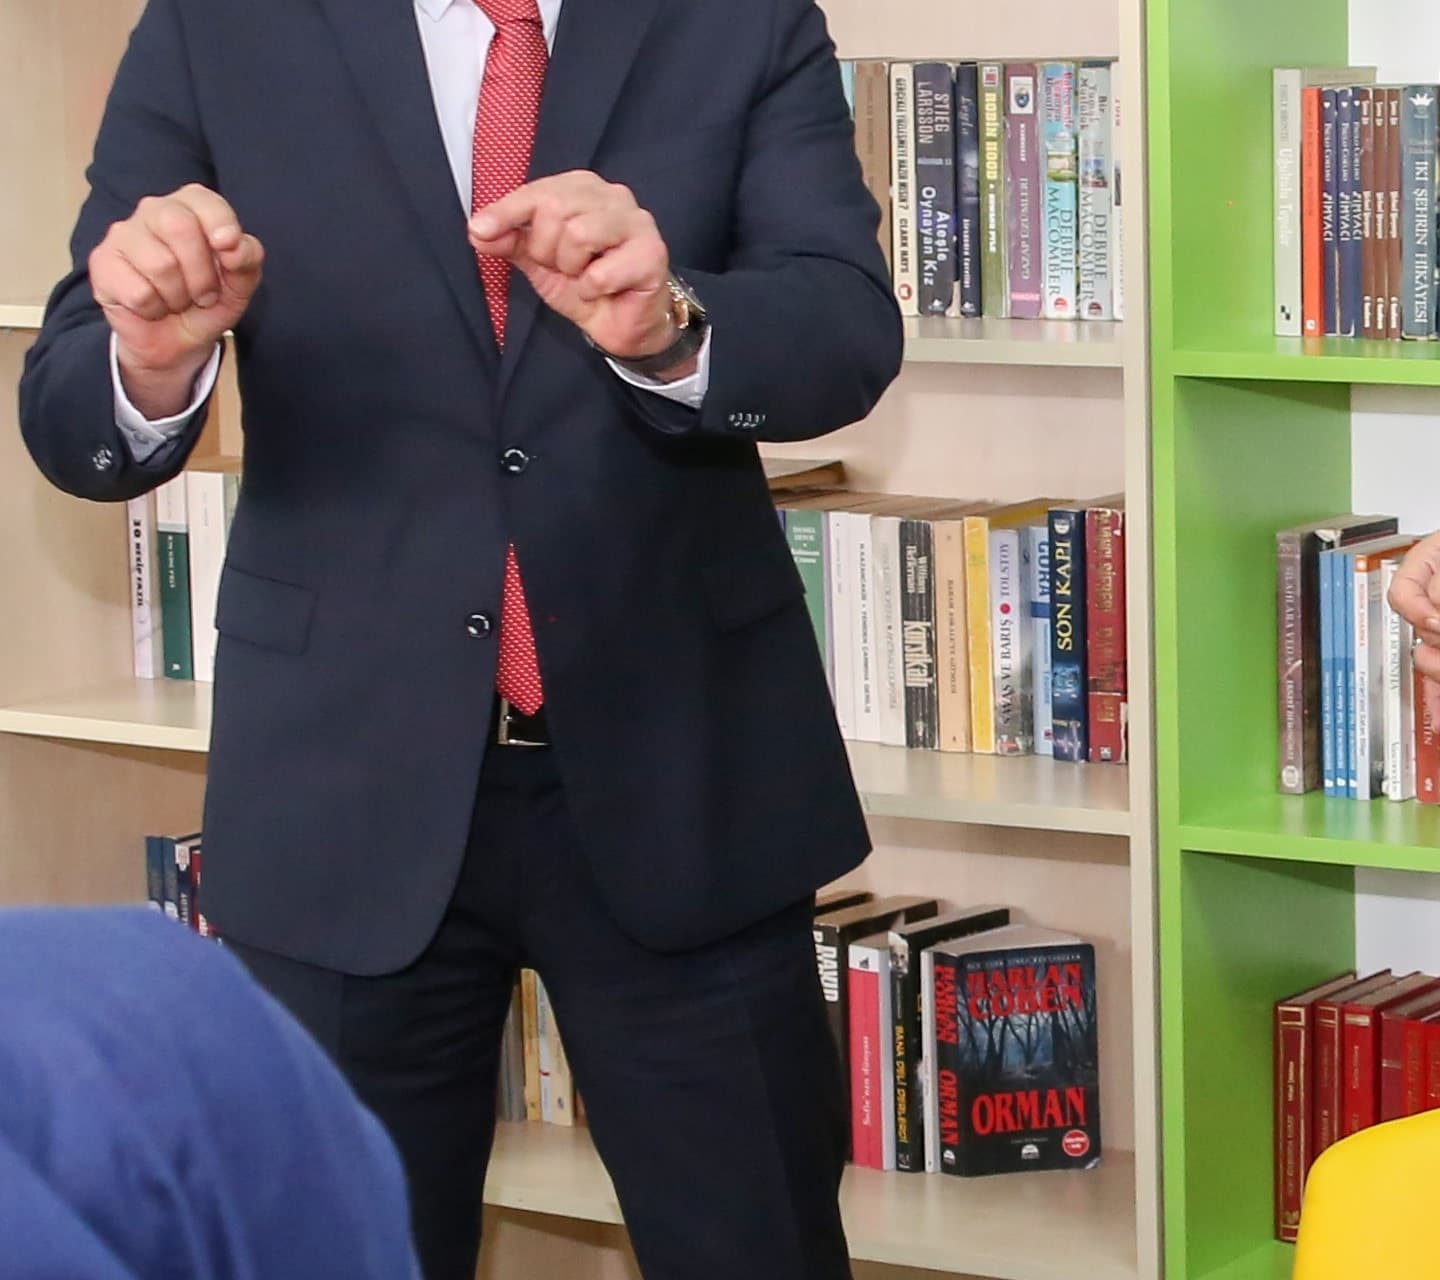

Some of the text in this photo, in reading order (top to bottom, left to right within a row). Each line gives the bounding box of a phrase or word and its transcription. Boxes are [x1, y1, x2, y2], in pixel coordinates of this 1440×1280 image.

[918, 81, 933, 144] LARSSON
[935, 94, 949, 132] STIEG
[920, 186, 937, 285] Oynayan Kız
[1047, 186, 1060, 296] MACOMBER
[1060, 209, 1072, 275] DEBBIE
[1094, 214, 1107, 278] DEBBIE
[1412, 189, 1428, 245] ŞEHRİN
[1057, 604, 1073, 651] SON
[939, 1069, 959, 1145] ORMAN
[971, 1086, 1088, 1136] ORMAN
